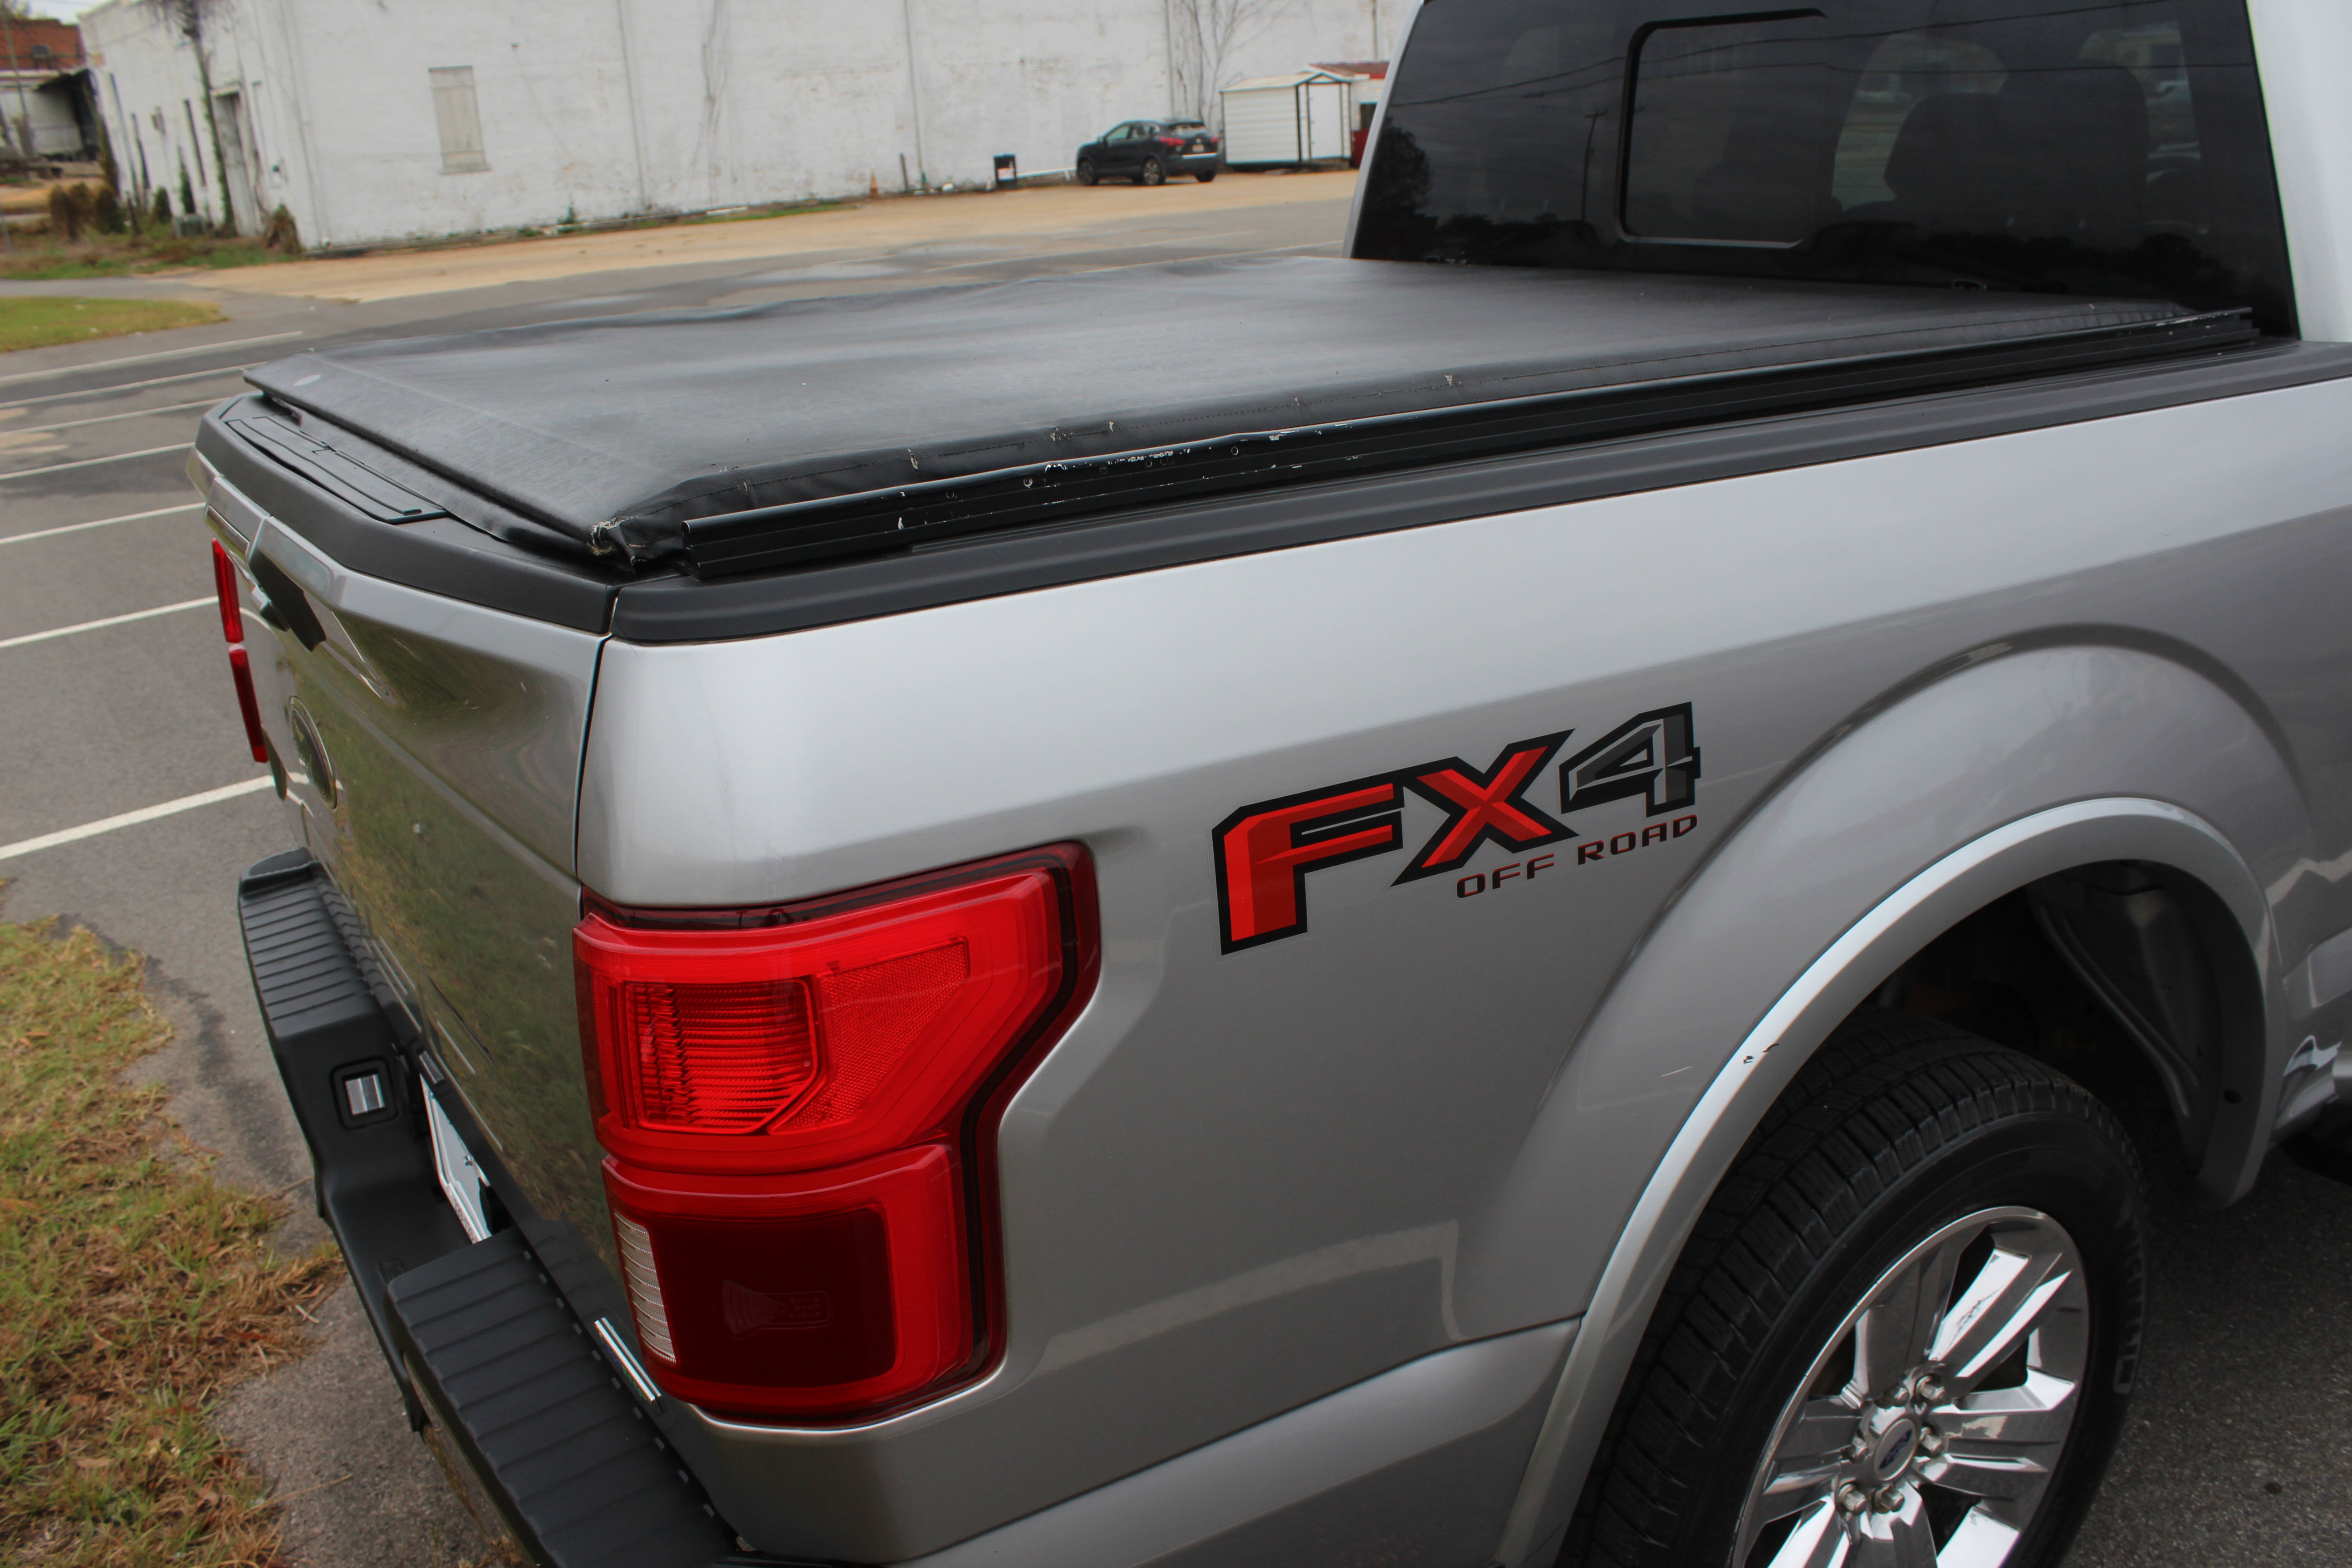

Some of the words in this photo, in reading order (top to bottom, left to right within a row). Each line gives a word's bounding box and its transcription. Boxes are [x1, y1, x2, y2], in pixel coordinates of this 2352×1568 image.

[1211, 701, 1701, 956] FX4
[1456, 853, 1555, 899] OFF
[1577, 814, 1698, 866] ROAD
